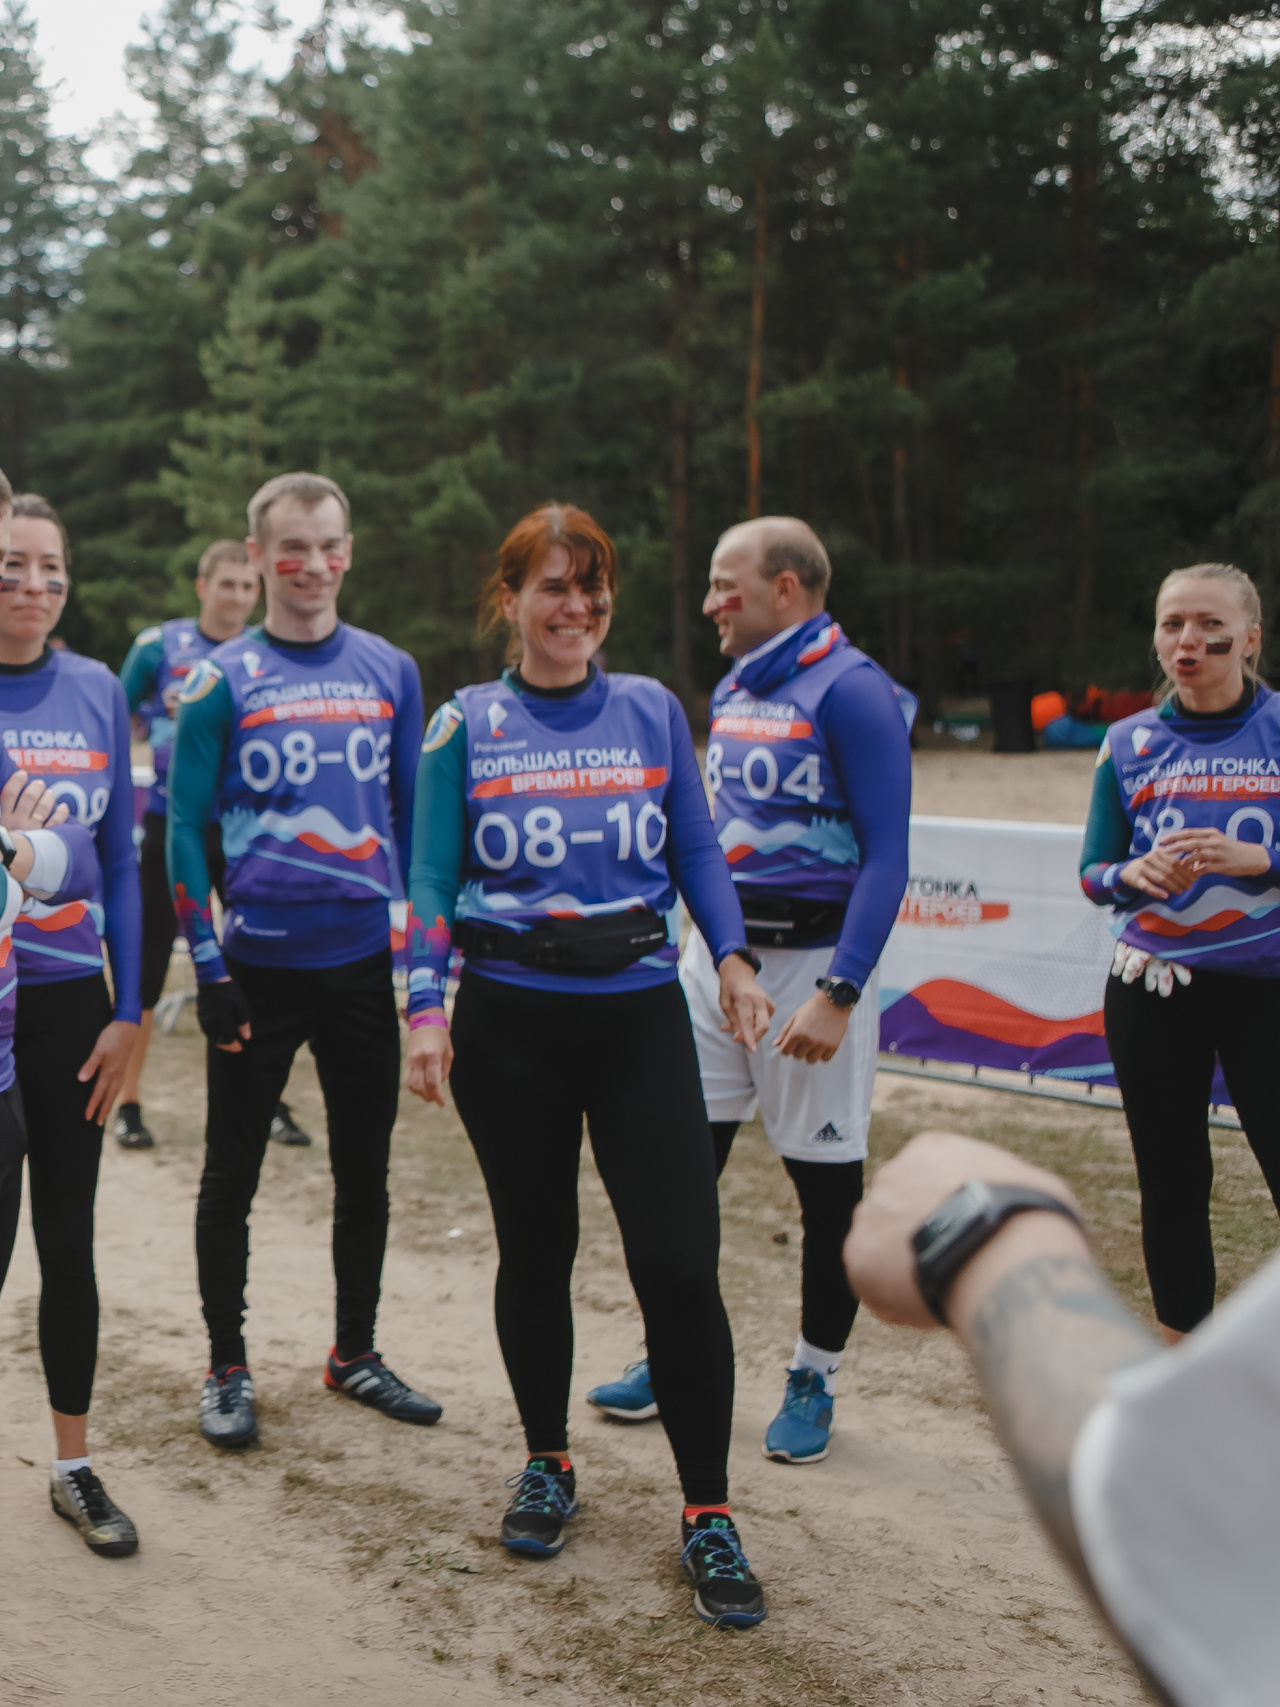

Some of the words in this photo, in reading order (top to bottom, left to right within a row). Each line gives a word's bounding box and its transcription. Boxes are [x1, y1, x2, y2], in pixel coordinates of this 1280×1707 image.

[470, 750, 570, 779] БОЛЬШАЯ
[575, 747, 643, 769] ГОНКА
[1211, 756, 1280, 776] ГОНКА
[511, 770, 575, 794] ВРЕМЯ
[578, 767, 645, 788] ГЕРОЕВ
[474, 801, 668, 871] 08-10
